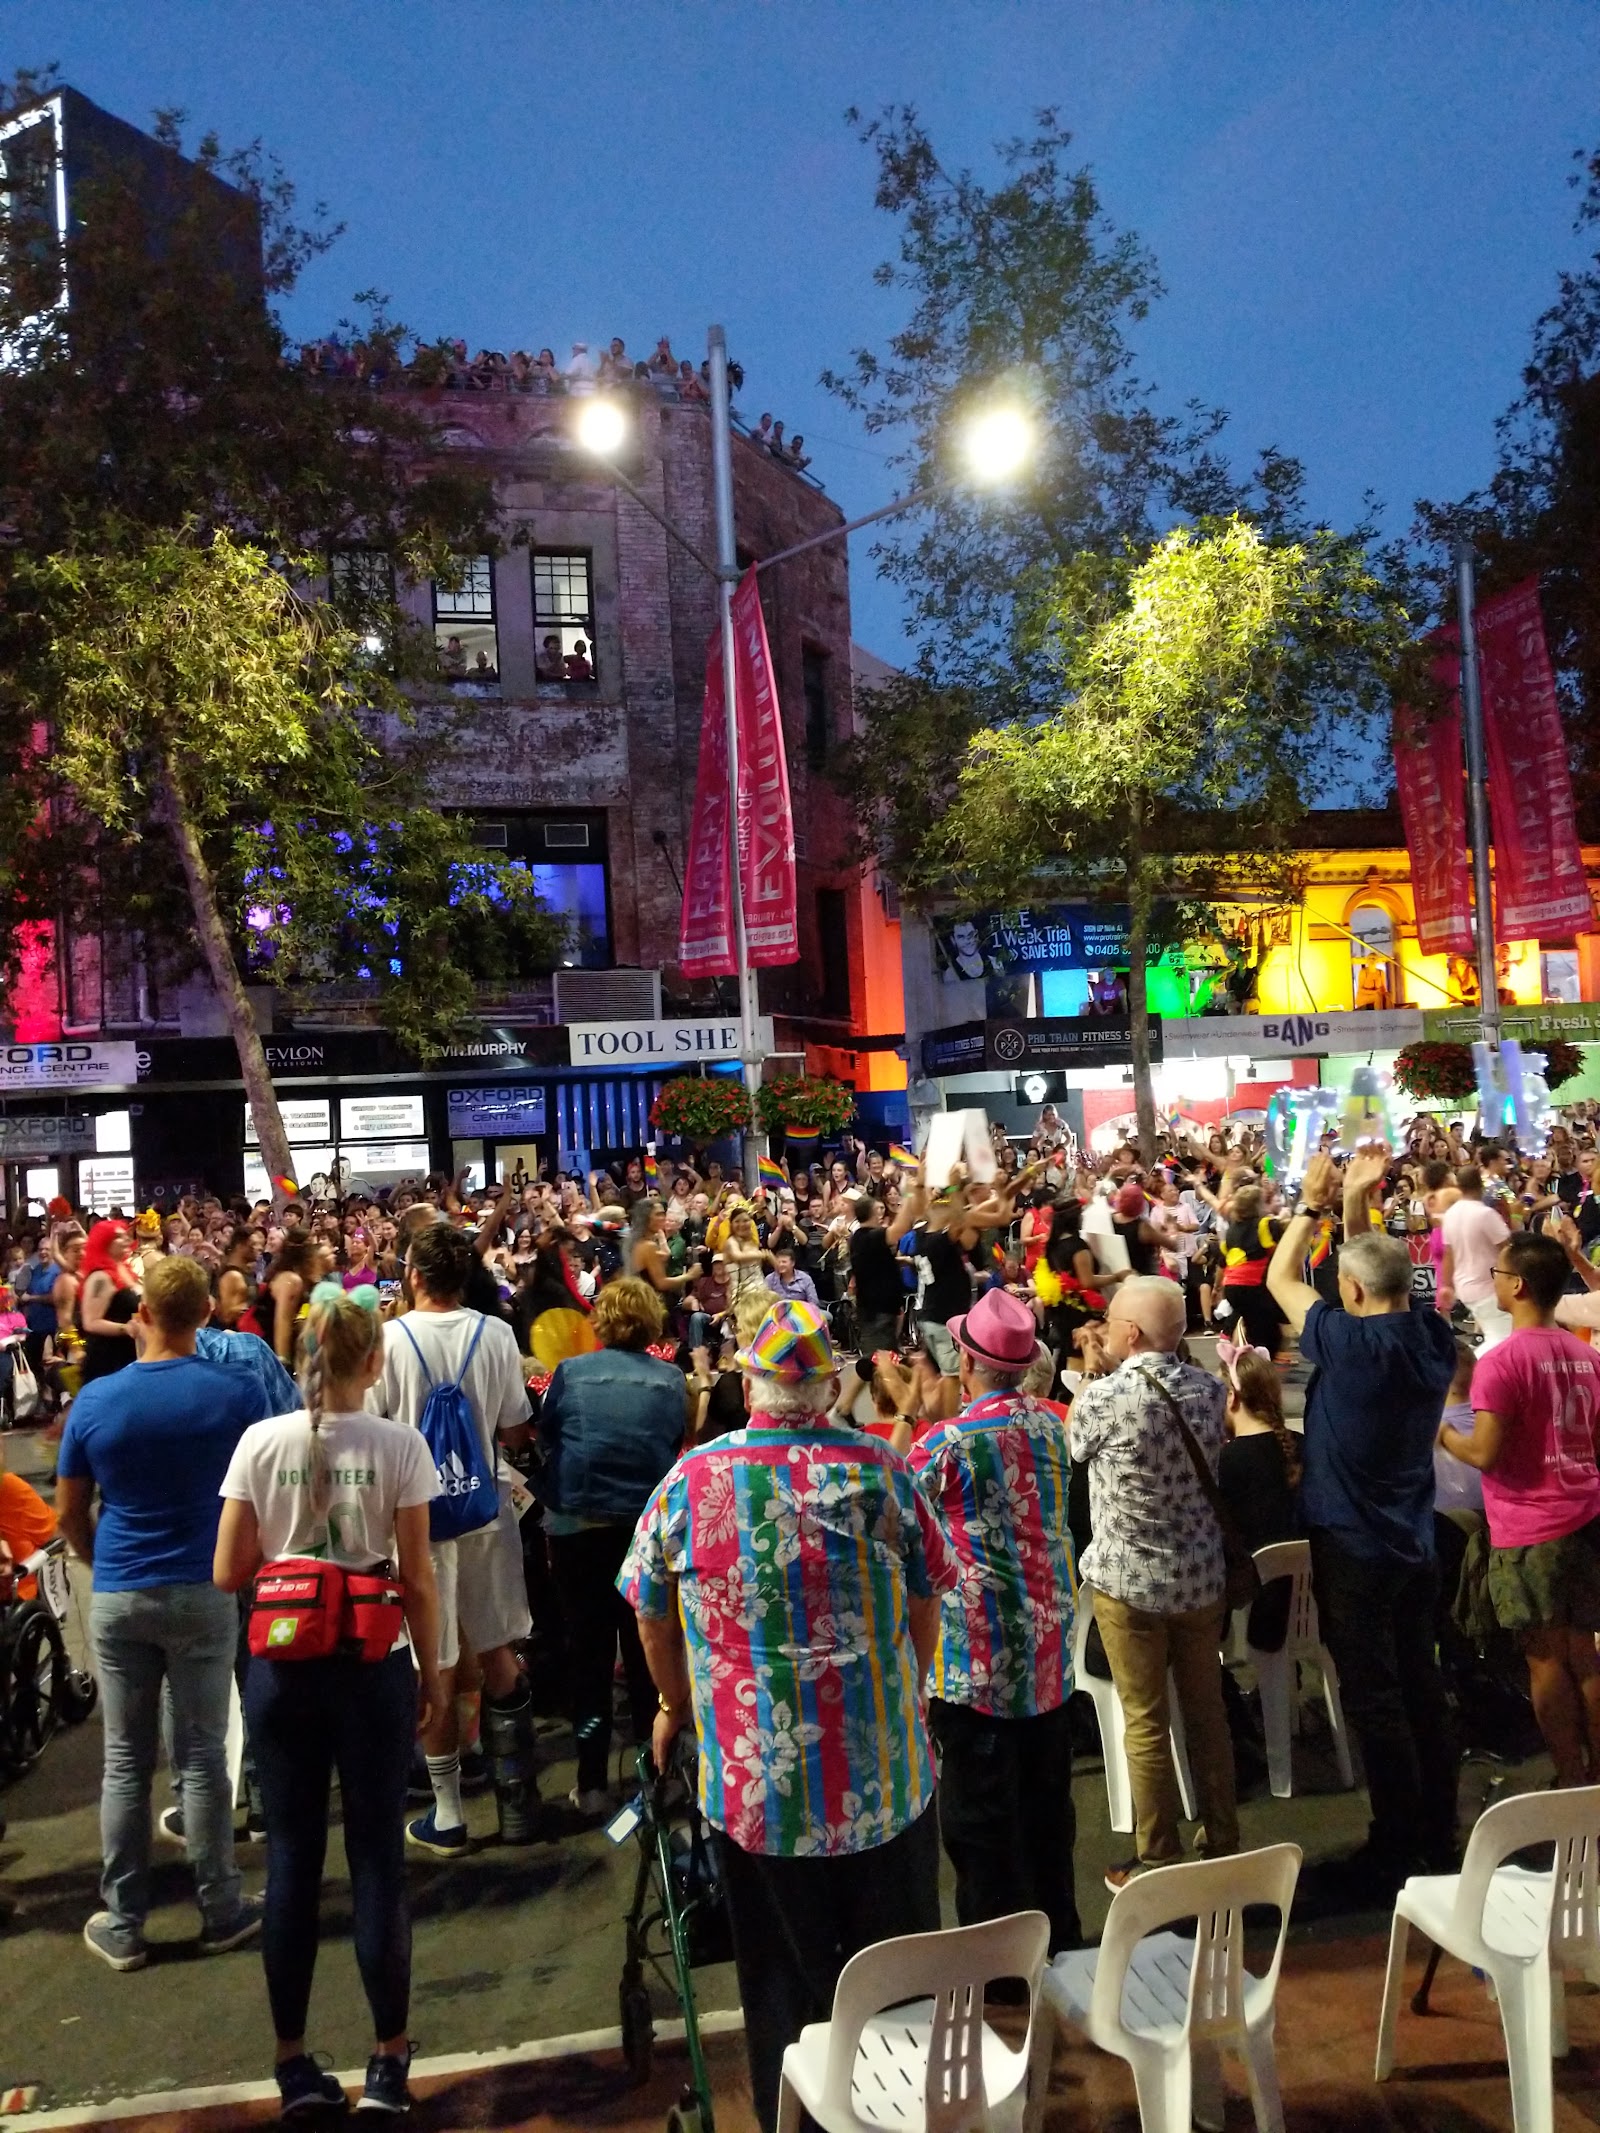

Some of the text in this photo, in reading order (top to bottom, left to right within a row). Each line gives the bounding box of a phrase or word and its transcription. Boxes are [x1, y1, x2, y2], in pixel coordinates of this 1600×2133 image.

[989, 911, 1031, 930] FRE
[1003, 928, 1043, 947] Week
[1043, 924, 1071, 943] Trial
[1021, 942, 1072, 960] SAVE $110
[1094, 945, 1120, 955] 0405
[1539, 1014, 1592, 1030] Fresh
[1028, 1029, 1158, 1044] PRO TRAIN FITNESS SIO
[1169, 1029, 1260, 1041] Swimwear Underwear
[1263, 1015, 1330, 1047] BANG
[577, 1027, 739, 1056] TOOL SHE
[0, 1046, 92, 1063] ORD
[266, 1046, 324, 1061] EVLON
[431, 1042, 528, 1058] EVIN.MURPHY
[41, 1062, 110, 1073] CENTRE
[450, 1088, 543, 1102] OXFORD
[472, 1112, 522, 1122] CENTRE
[278, 1468, 375, 1487] VOLTEER
[280, 1583, 295, 1592] AID
[295, 1582, 310, 1592] KIT
